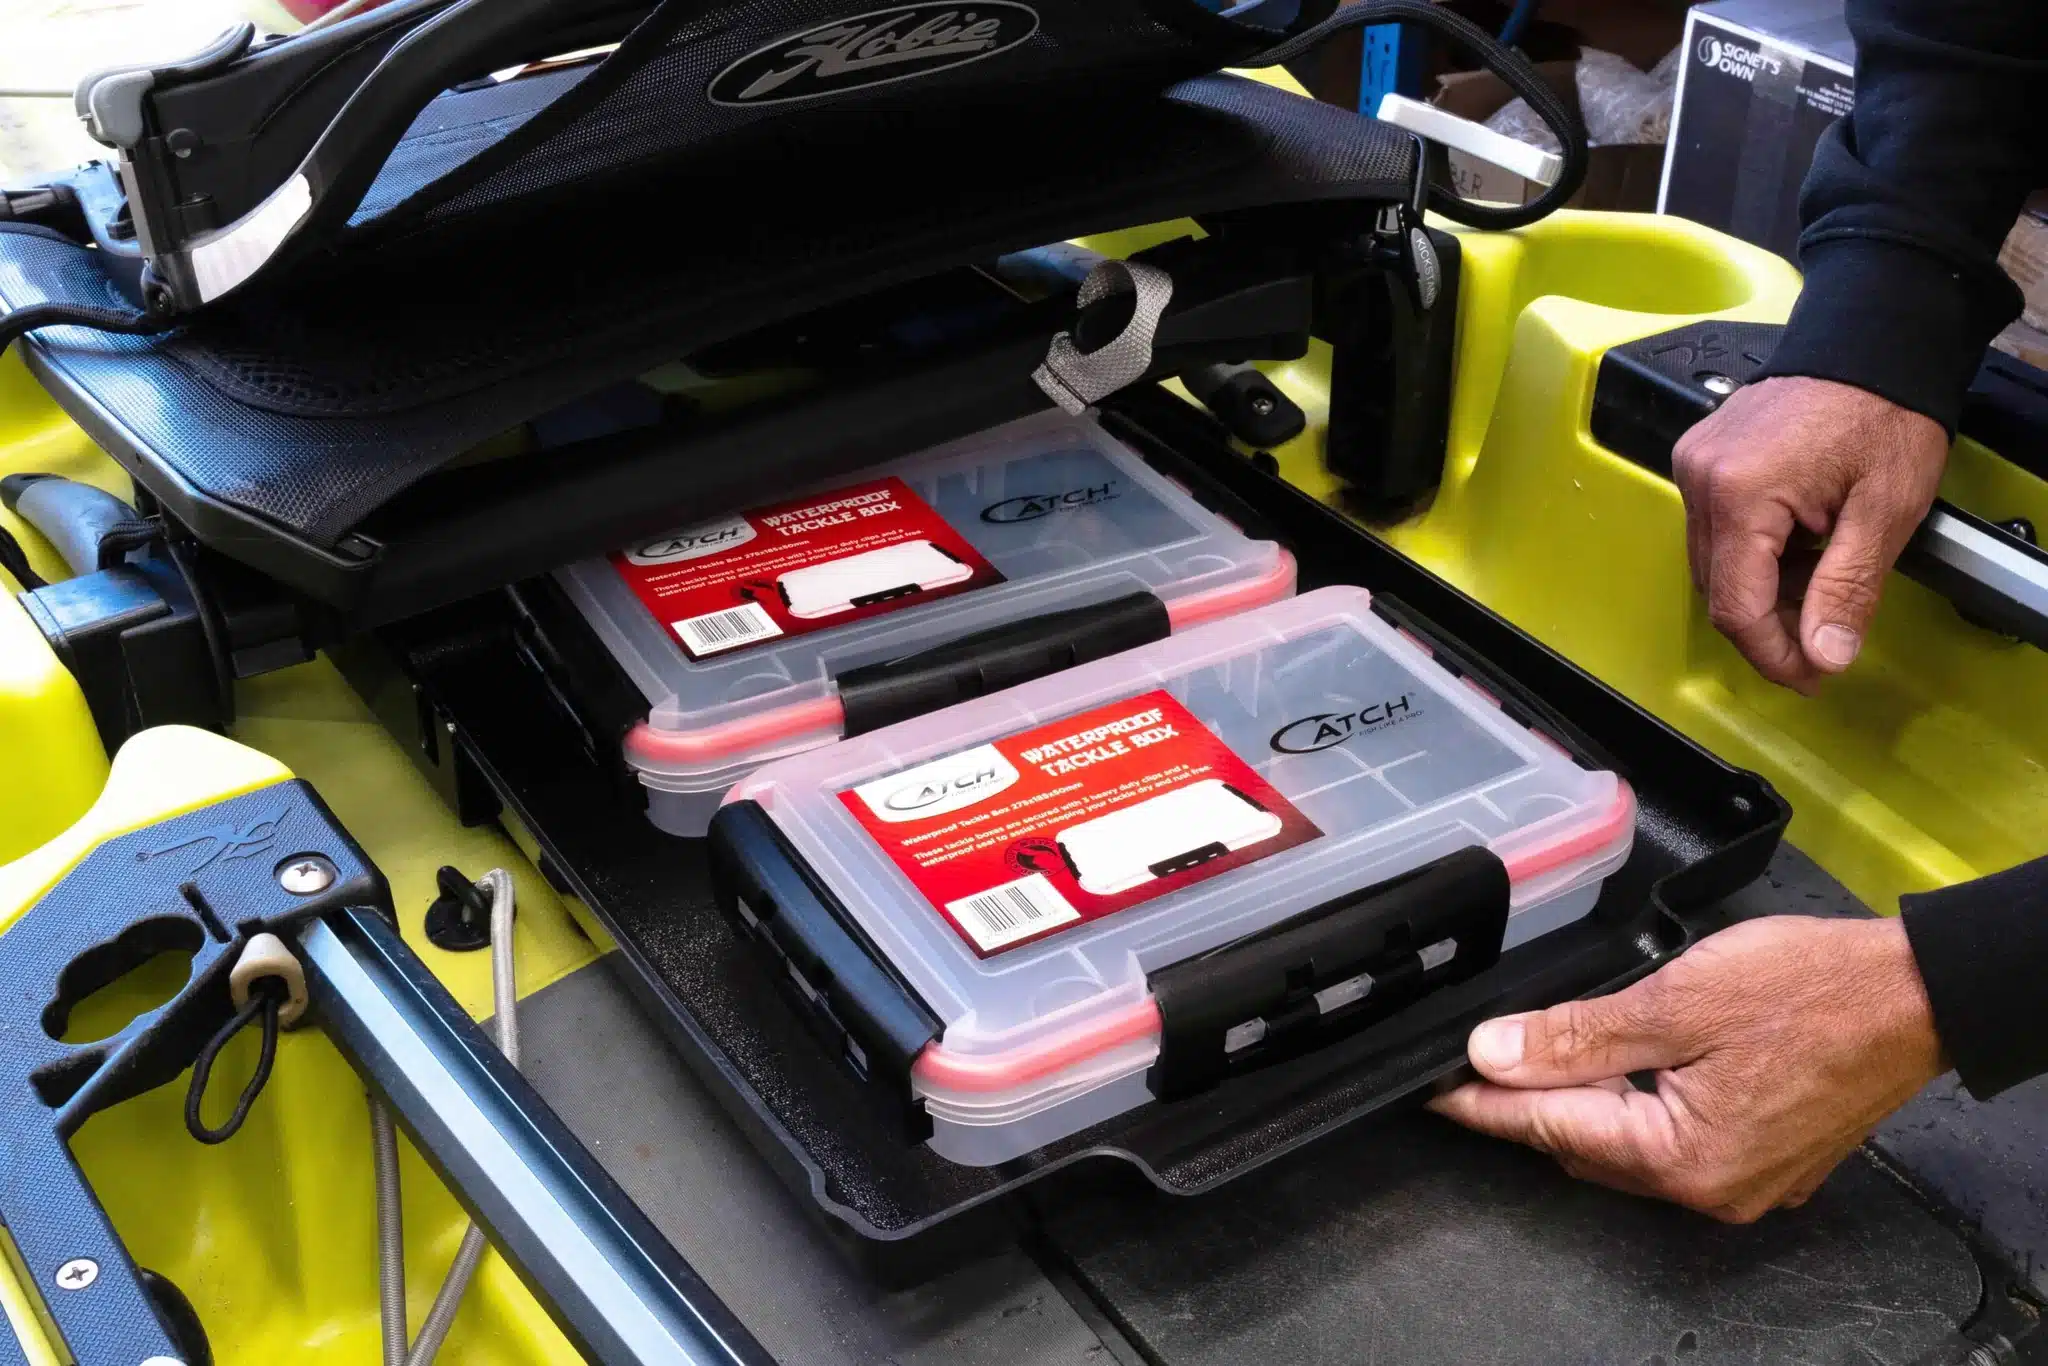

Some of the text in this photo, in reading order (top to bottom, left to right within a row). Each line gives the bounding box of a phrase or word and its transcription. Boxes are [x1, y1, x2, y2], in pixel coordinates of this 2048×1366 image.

[738, 11, 1000, 99] Hobie
[1719, 58, 1755, 82] OWN
[1722, 42, 1782, 75] SIGNET'S
[1416, 237, 1437, 304] KICKSTAND
[761, 489, 892, 528] WATERPROOF
[776, 500, 902, 537] TACKLE BOX
[635, 526, 739, 558] CATCH
[645, 565, 696, 583] Waterproof
[697, 560, 725, 570] Tackle
[725, 555, 742, 564] Box
[653, 582, 680, 593] These
[680, 575, 708, 586] tackle
[708, 569, 735, 579] boxes
[736, 565, 751, 573] are
[751, 557, 785, 570] secured
[787, 550, 805, 560] with
[814, 544, 838, 555] heavy
[839, 539, 859, 548] duty
[860, 533, 881, 543] clips
[881, 529, 897, 538] and
[657, 581, 706, 598] waterproof
[707, 577, 725, 586] seal
[738, 569, 762, 579] assist
[773, 557, 807, 570] keeping
[808, 552, 827, 562] your
[828, 545, 855, 556] tackle
[855, 541, 870, 551] dry
[871, 538, 886, 546] and
[888, 533, 904, 542] rust
[1020, 707, 1164, 764] WATERPROOF
[1040, 723, 1179, 777] TACKLE BOX
[1270, 695, 1410, 754] CATCH
[901, 823, 958, 846] Waterproof
[958, 813, 990, 828] Tackle
[991, 806, 1011, 817] Box
[914, 847, 944, 860] These
[944, 837, 975, 851] tackle
[975, 827, 1005, 840] boxes
[1006, 821, 1022, 830] are
[1022, 807, 1060, 824] secured
[1061, 800, 1082, 812] with
[1089, 787, 1118, 801] heavy
[1119, 779, 1140, 792] duty
[1141, 772, 1163, 784] clips
[1163, 765, 1181, 776] and
[920, 846, 974, 867] waterproof
[976, 838, 996, 849] seal
[998, 834, 1008, 842] to
[1010, 822, 1036, 837] assist
[1037, 819, 1047, 828] in
[1048, 807, 1086, 825] keeping
[1086, 800, 1106, 812] your
[1108, 790, 1137, 803] tackle
[1137, 784, 1153, 794] dry
[1154, 777, 1172, 787] and
[1173, 772, 1191, 782] rust
